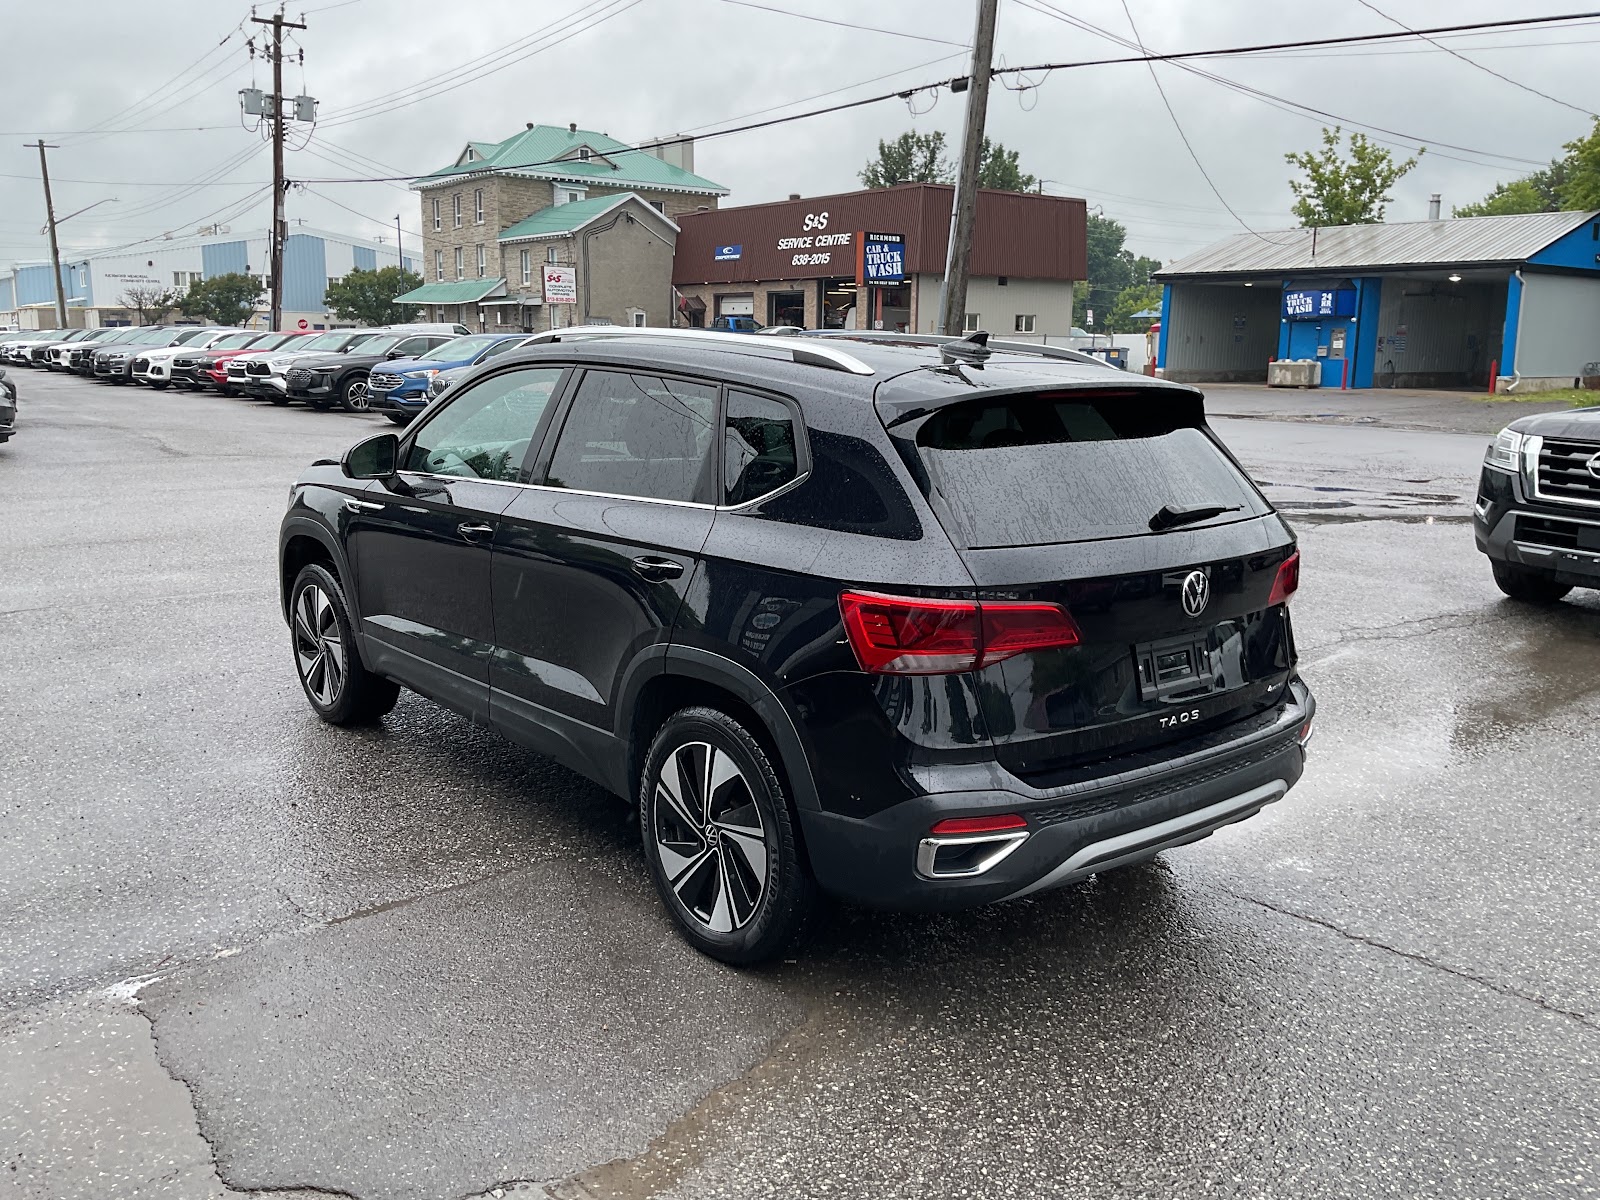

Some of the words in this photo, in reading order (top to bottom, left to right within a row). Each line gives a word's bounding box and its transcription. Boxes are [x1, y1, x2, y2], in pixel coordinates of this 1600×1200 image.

[802, 212, 829, 231] S&S
[777, 237, 814, 250] SERVICE
[815, 233, 852, 247] CENTRE
[869, 234, 900, 242] RICHMOND
[866, 245, 881, 253] CAR
[883, 244, 889, 252] &
[791, 253, 831, 266] 838-2015
[866, 251, 901, 264] TRUCK
[867, 262, 902, 277] WASH
[1286, 297, 1313, 307] TRUCK
[1286, 303, 1313, 315] WASH
[1159, 709, 1200, 729] TAOS
